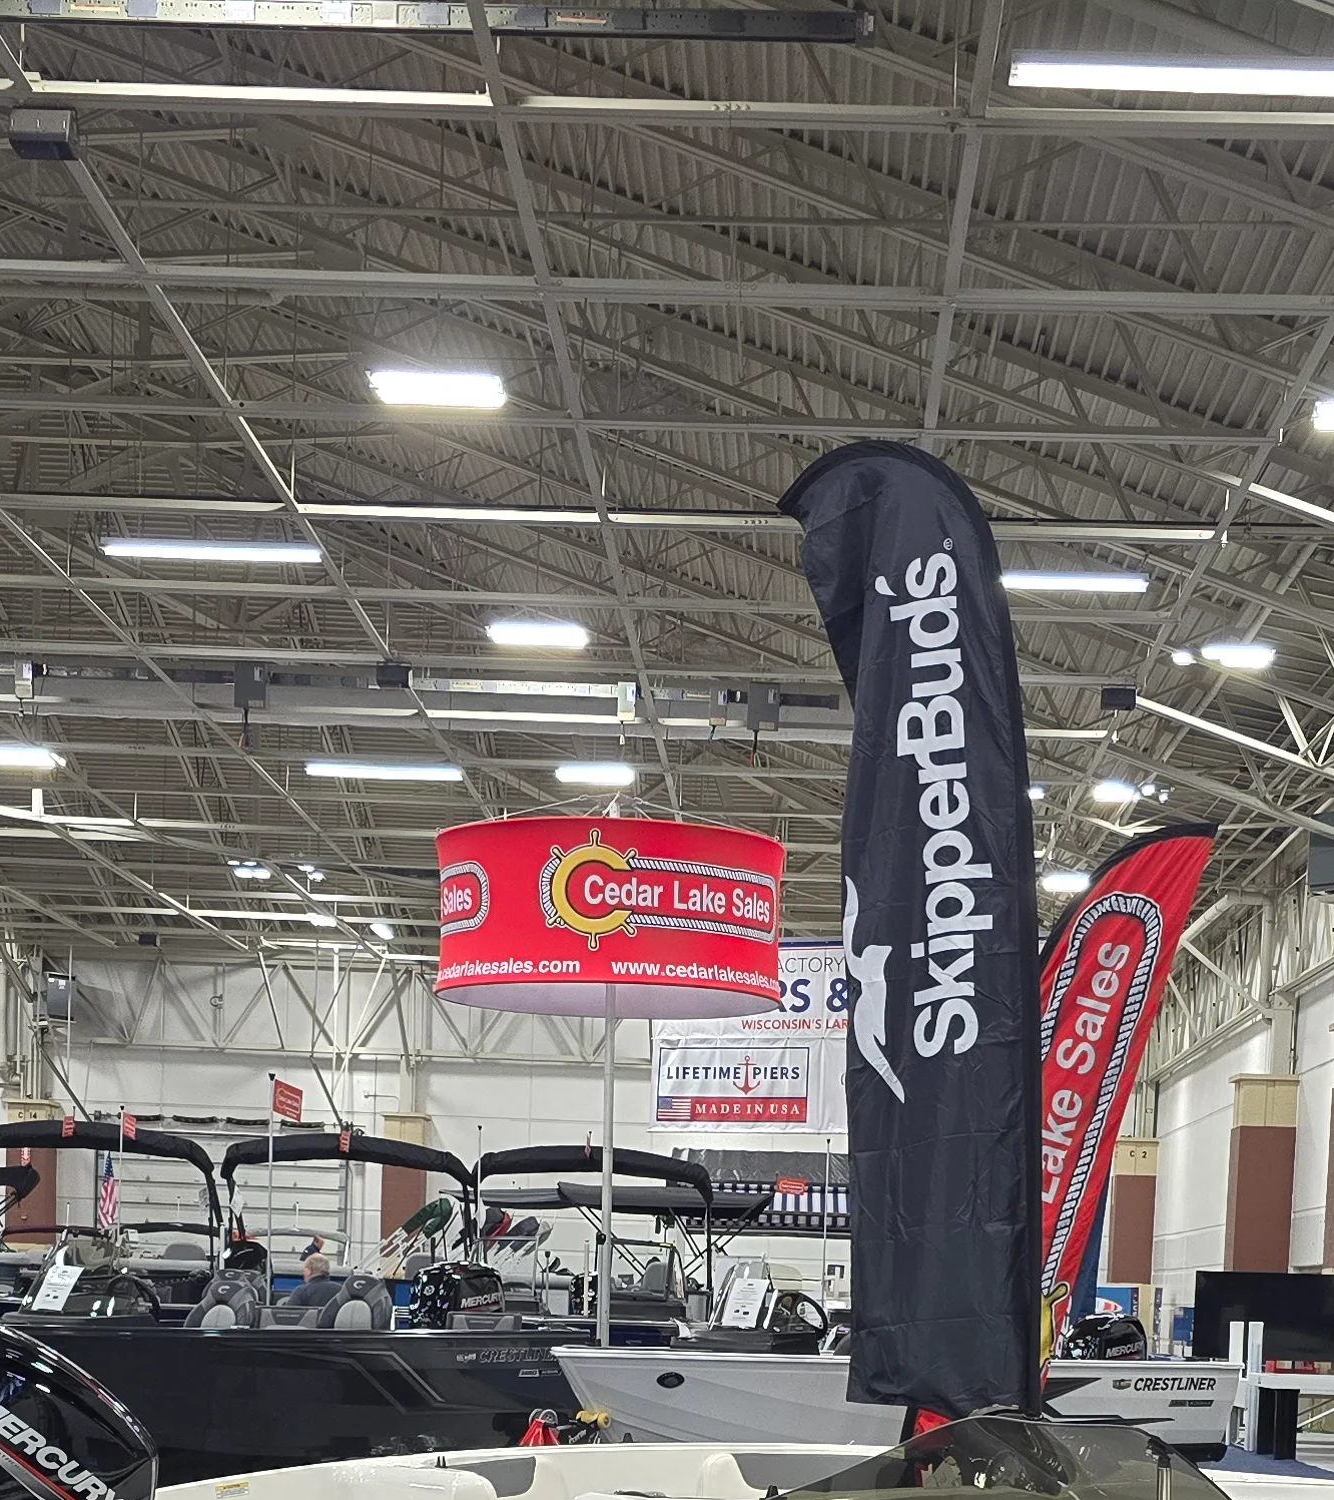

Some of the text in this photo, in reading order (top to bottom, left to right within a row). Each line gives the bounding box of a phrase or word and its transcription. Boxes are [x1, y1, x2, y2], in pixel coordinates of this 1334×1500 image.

[875, 550, 994, 1058] SkipperBud's
[443, 885, 473, 917] Sales
[584, 875, 770, 924] Cedar Lake Sales
[778, 957, 846, 973] ACTORY
[1056, 942, 1130, 1076] Sales
[741, 1018, 849, 1031] WISCONSIN'S LAR
[666, 1066, 800, 1080] LIFETIME PIERS
[694, 1103, 800, 1115] MADE IN USA
[1042, 1088, 1083, 1204] Lake
[478, 1347, 560, 1363] CRESTLINE
[1133, 1377, 1216, 1392] CRESTLINER
